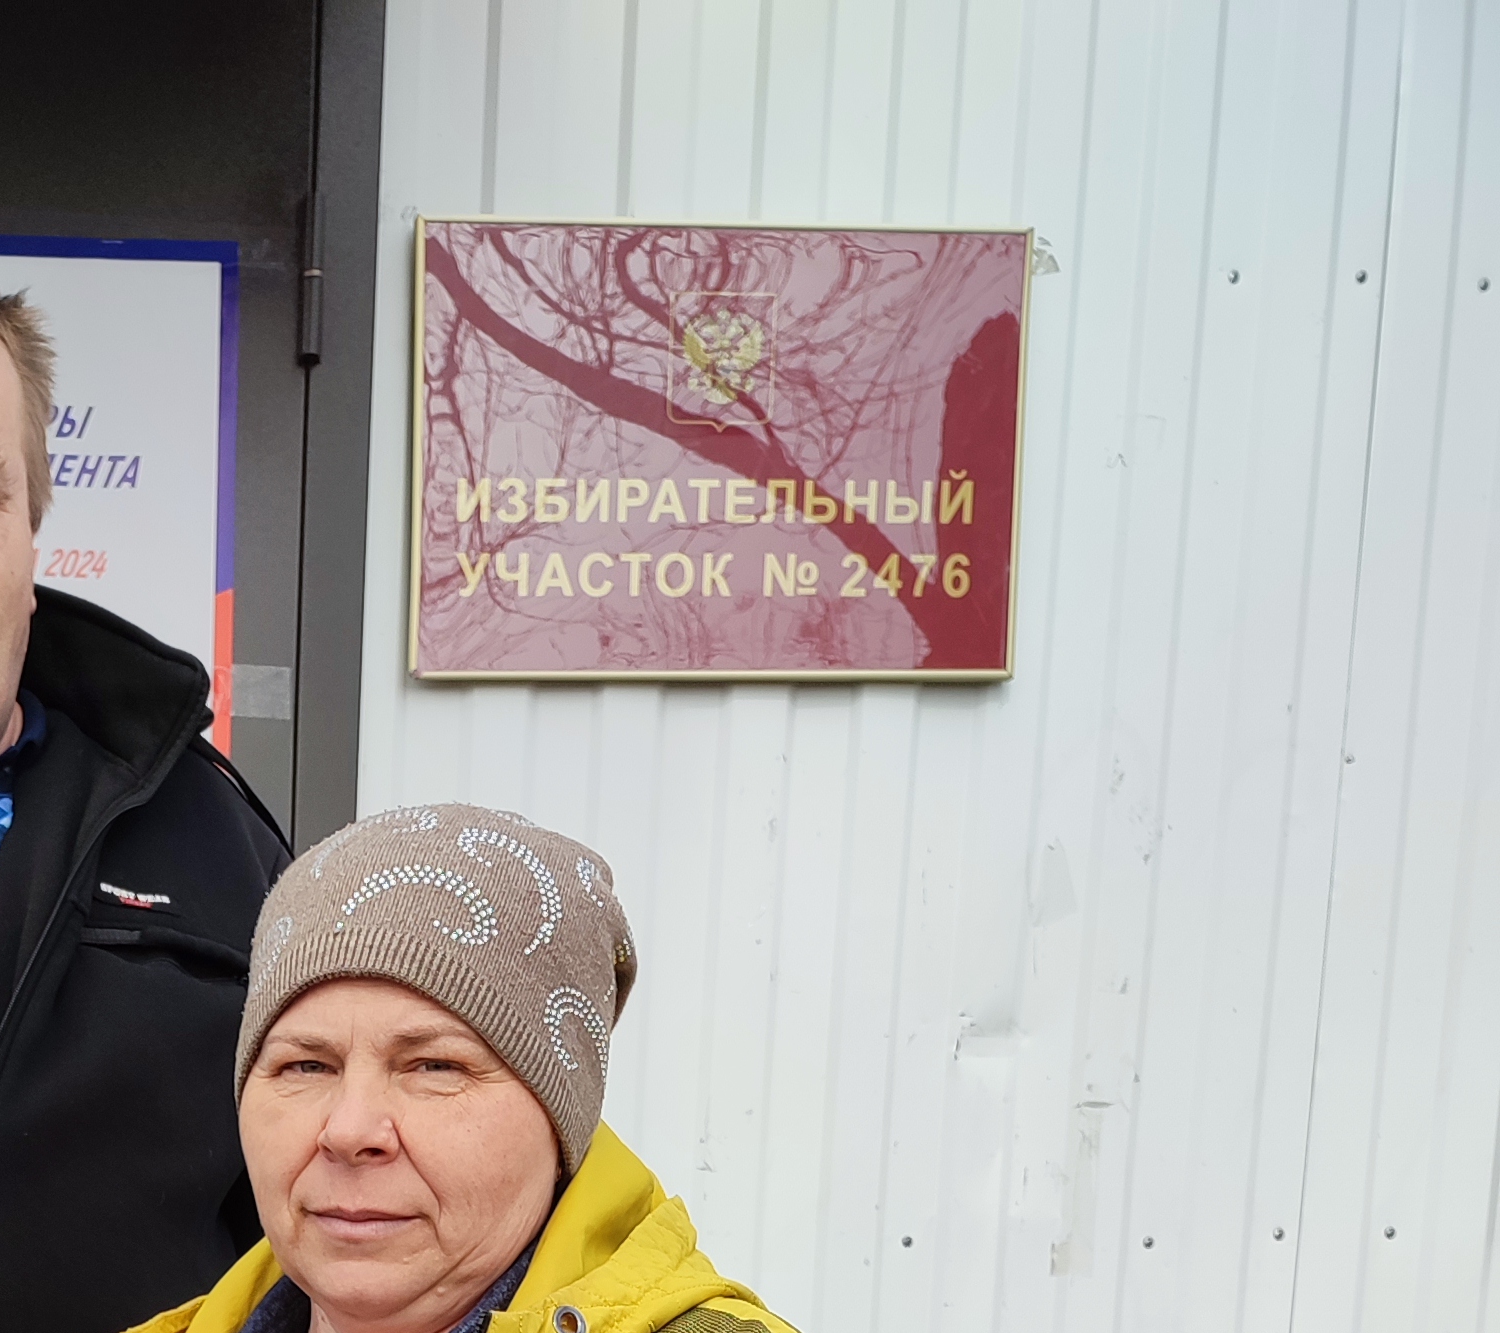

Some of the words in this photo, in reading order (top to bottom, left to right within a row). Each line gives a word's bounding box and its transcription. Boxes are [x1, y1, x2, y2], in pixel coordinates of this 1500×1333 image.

[456, 469, 975, 525] ИЗБИРАТЕЛЬНЫЙ
[45, 548, 108, 579] 2024
[457, 551, 734, 599] УЧАСТОК
[762, 552, 821, 598] №
[840, 553, 973, 599] 2476
